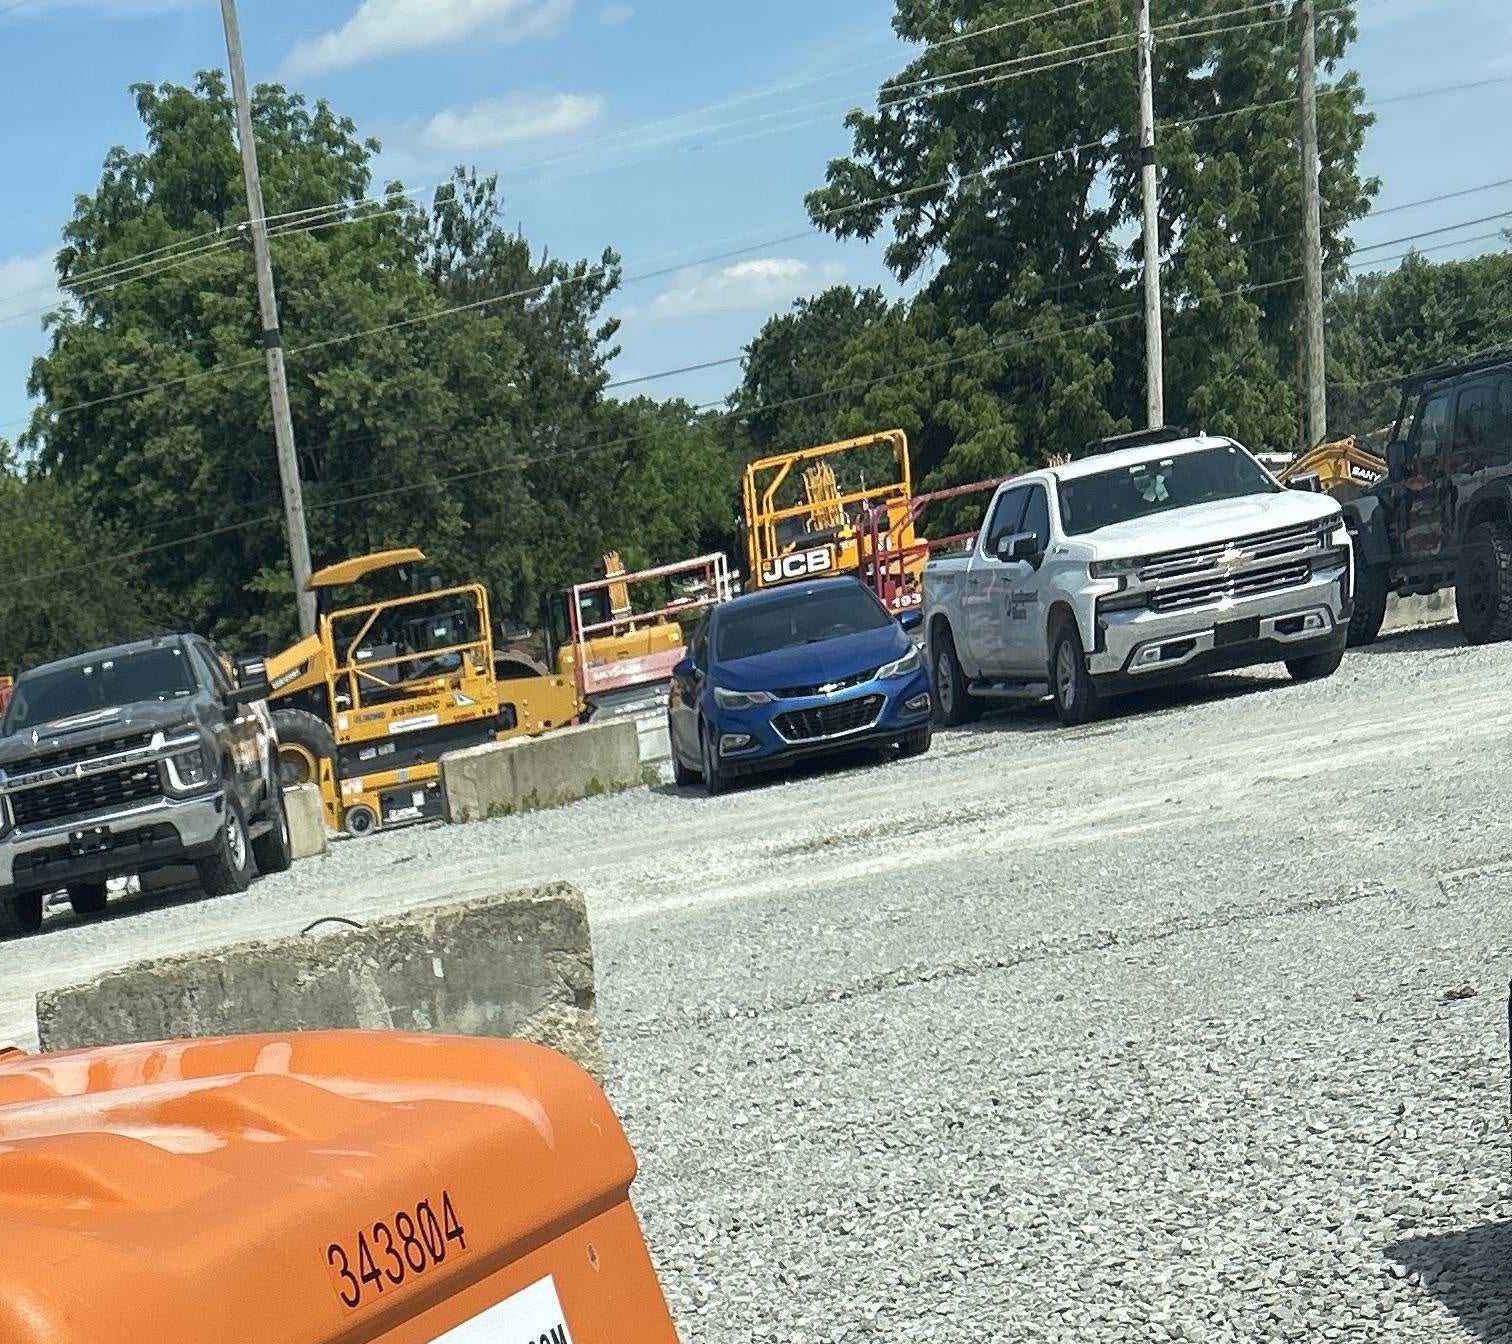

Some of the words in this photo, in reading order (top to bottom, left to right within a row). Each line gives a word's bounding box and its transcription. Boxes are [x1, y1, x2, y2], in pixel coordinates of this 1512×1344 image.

[1351, 466, 1382, 482] SANY
[763, 549, 831, 583] JCB
[327, 1190, 467, 1308] 343804
